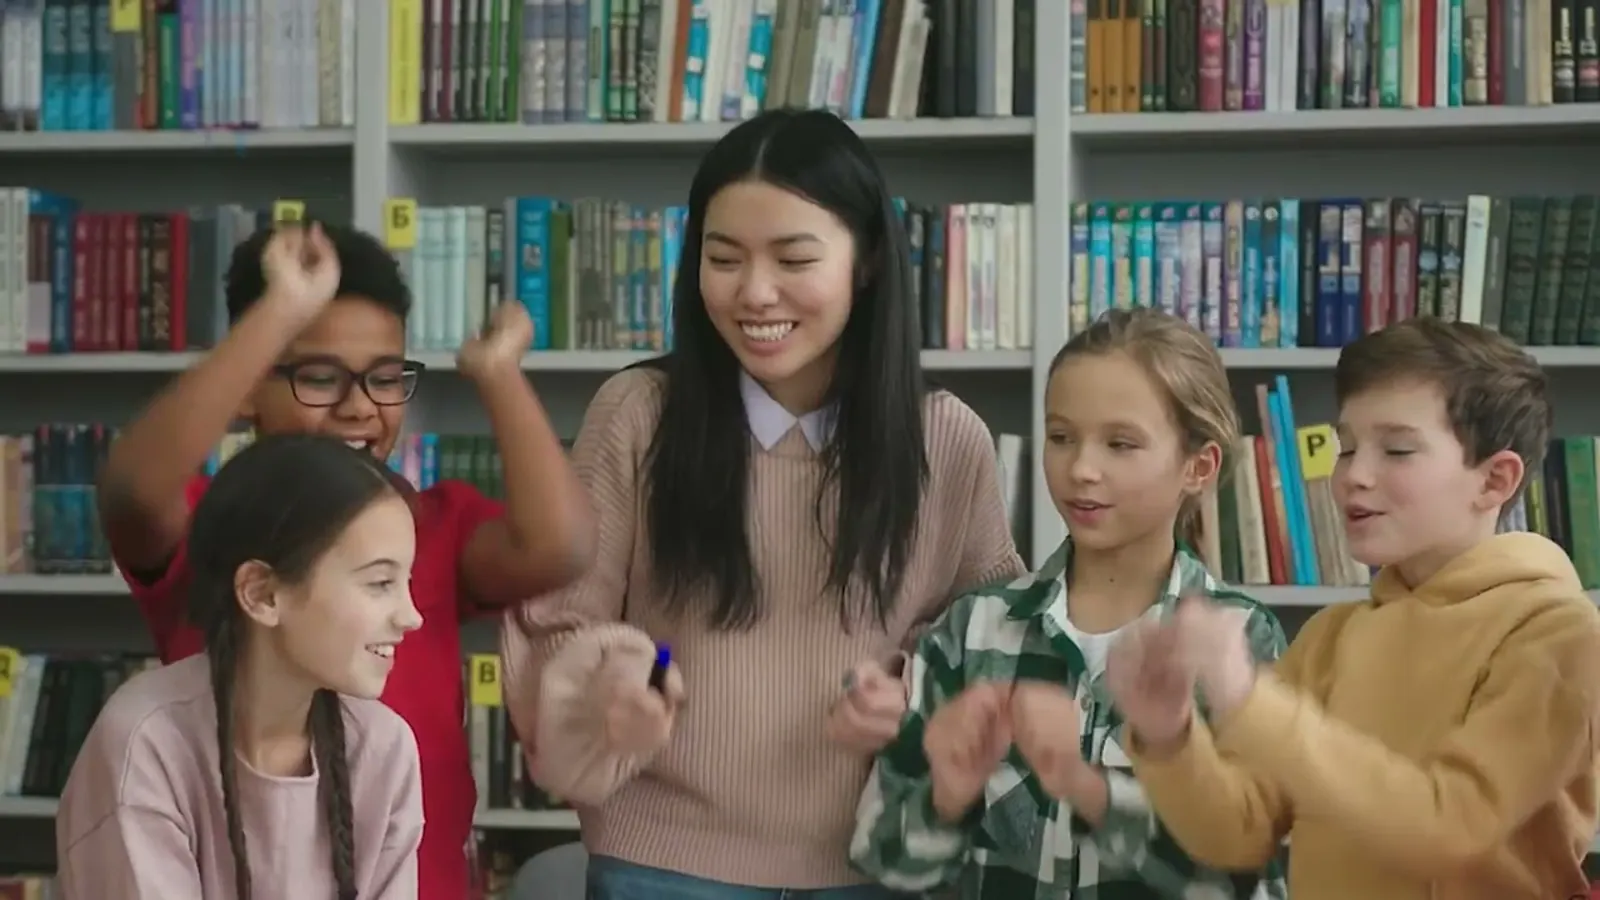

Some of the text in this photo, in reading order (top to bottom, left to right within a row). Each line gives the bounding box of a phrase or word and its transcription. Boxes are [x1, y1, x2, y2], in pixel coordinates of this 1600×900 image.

[392, 204, 410, 229] Б
[1306, 433, 1326, 458] Р
[480, 661, 496, 684] В
